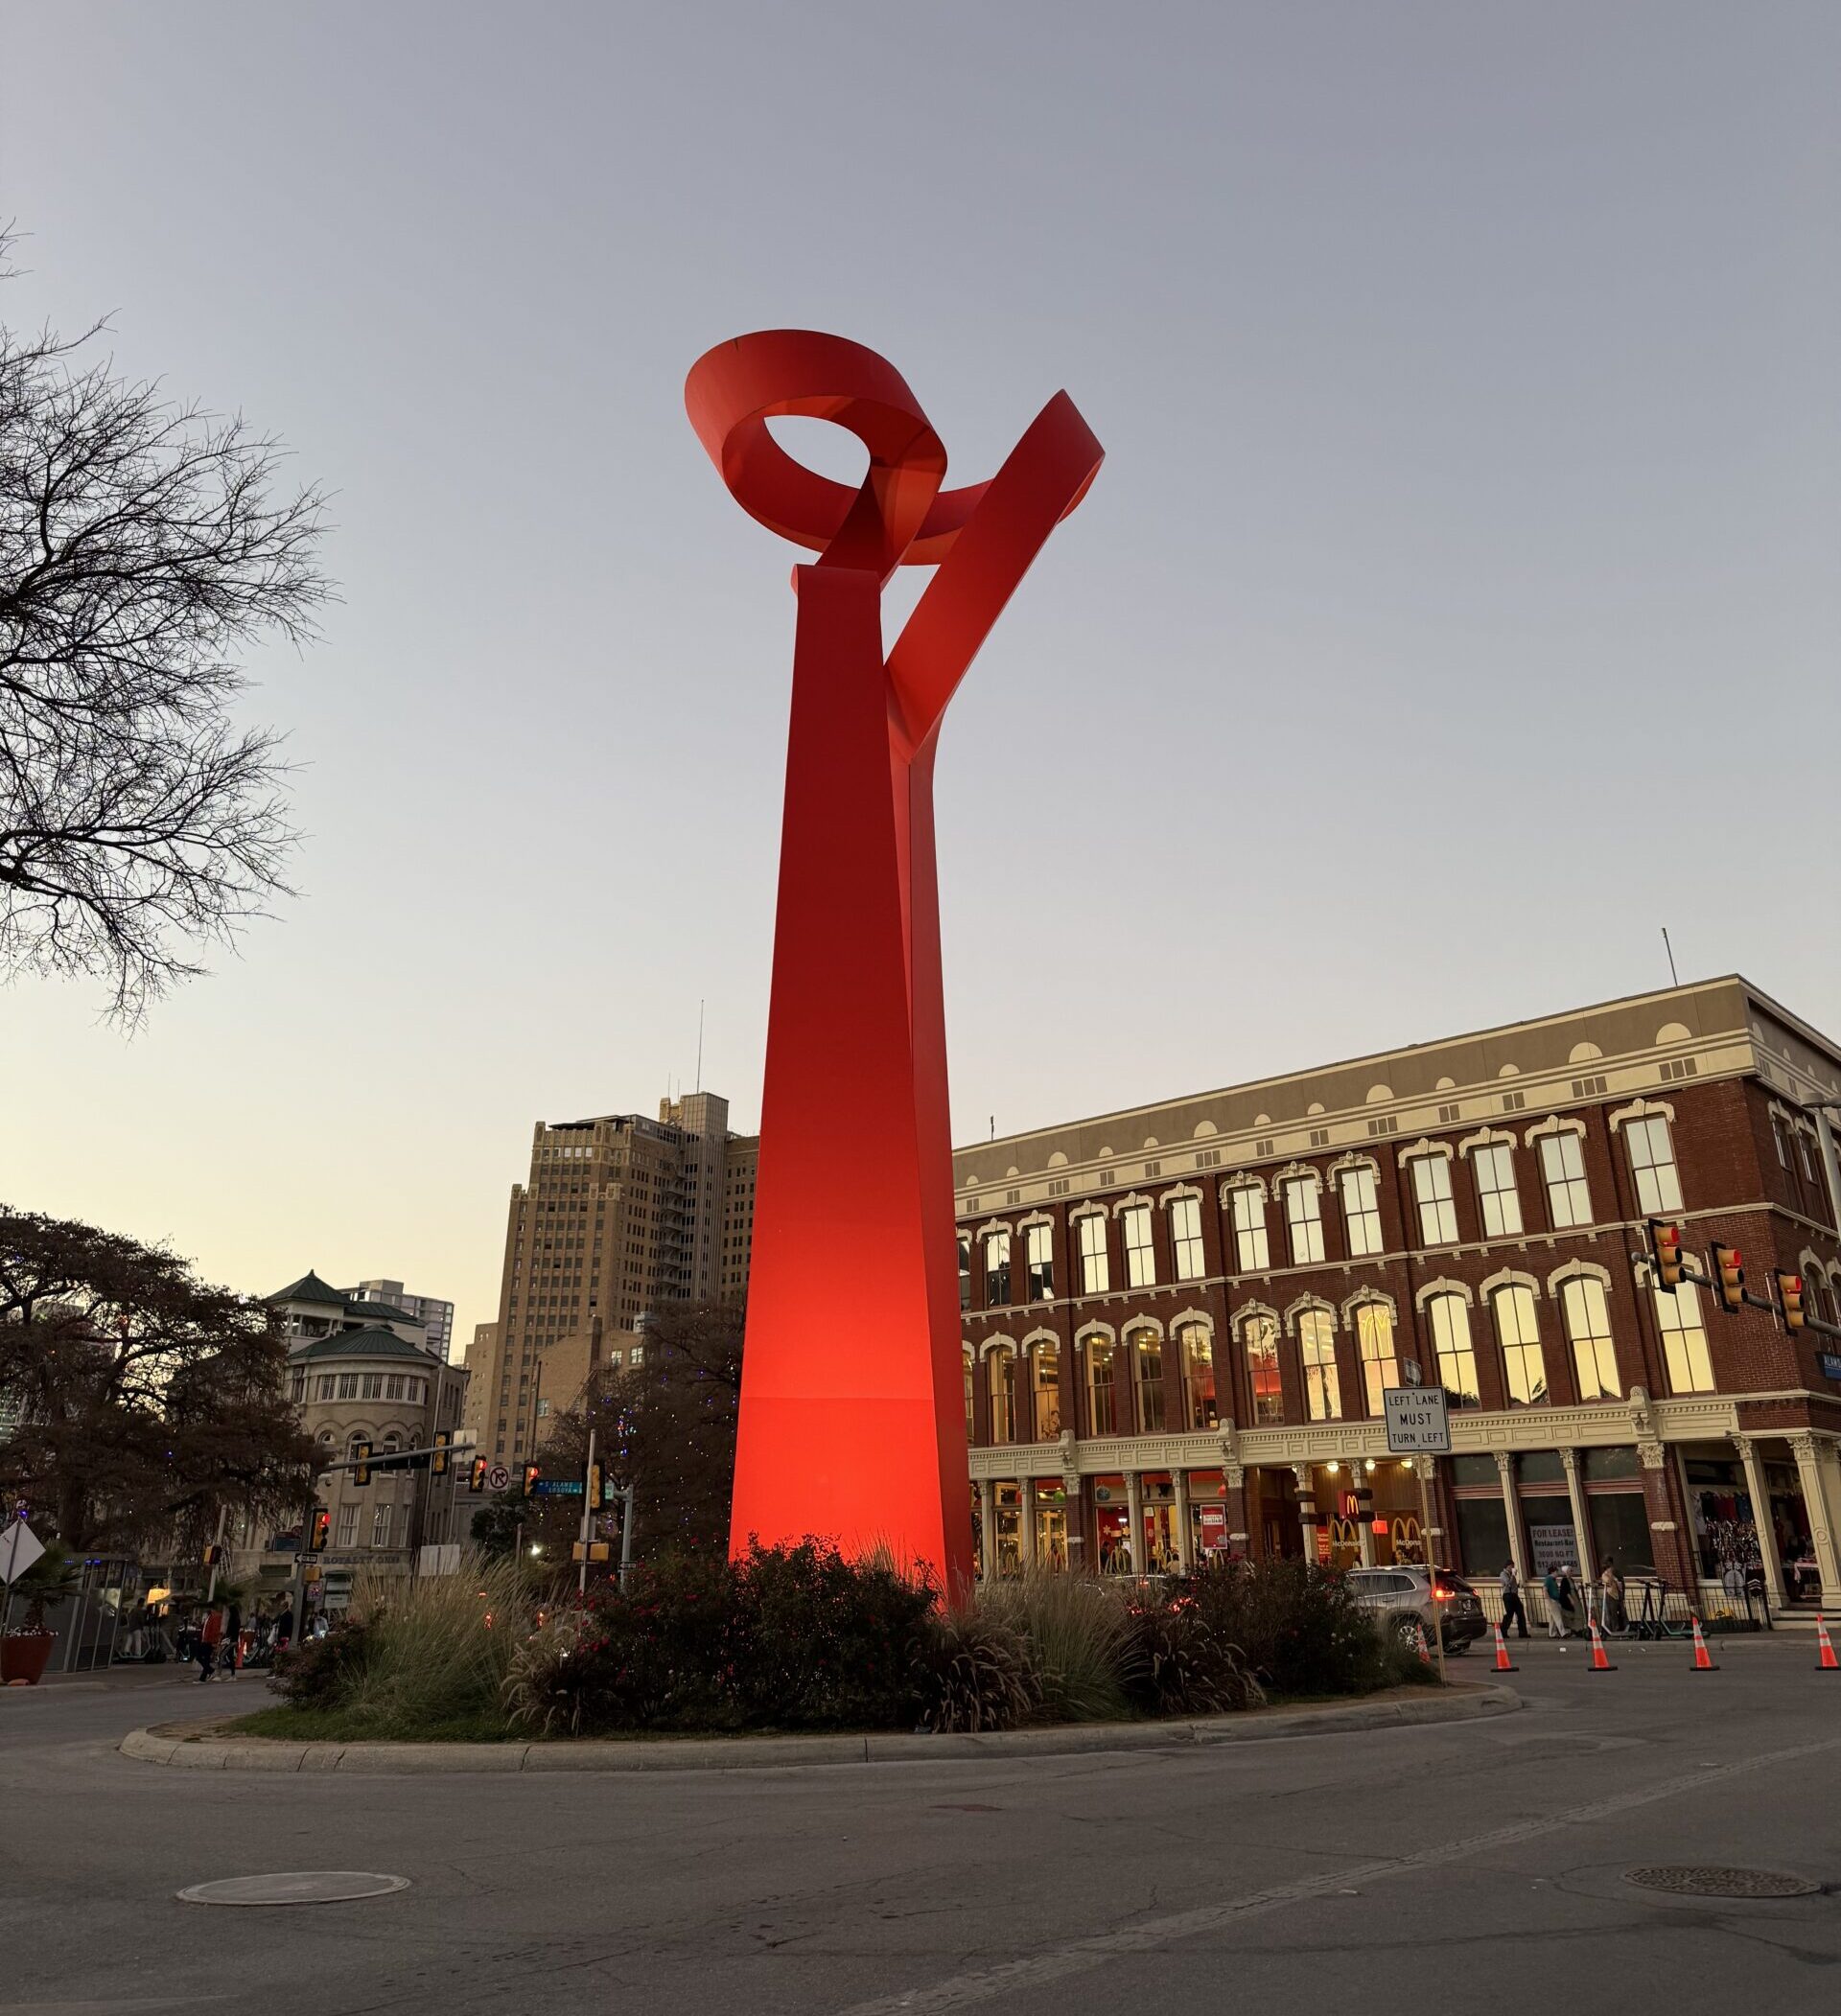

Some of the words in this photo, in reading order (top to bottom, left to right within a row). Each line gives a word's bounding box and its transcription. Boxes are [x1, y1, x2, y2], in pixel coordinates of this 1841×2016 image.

[1388, 1396, 1410, 1406] LEFT
[1415, 1395, 1439, 1405] LANE
[1400, 1412, 1432, 1425] MUST
[1391, 1433, 1416, 1444] TURN
[1422, 1432, 1444, 1443] LEFT
[1532, 1529, 1547, 1538] FOR
[322, 1556, 374, 1564] ROYALTY
